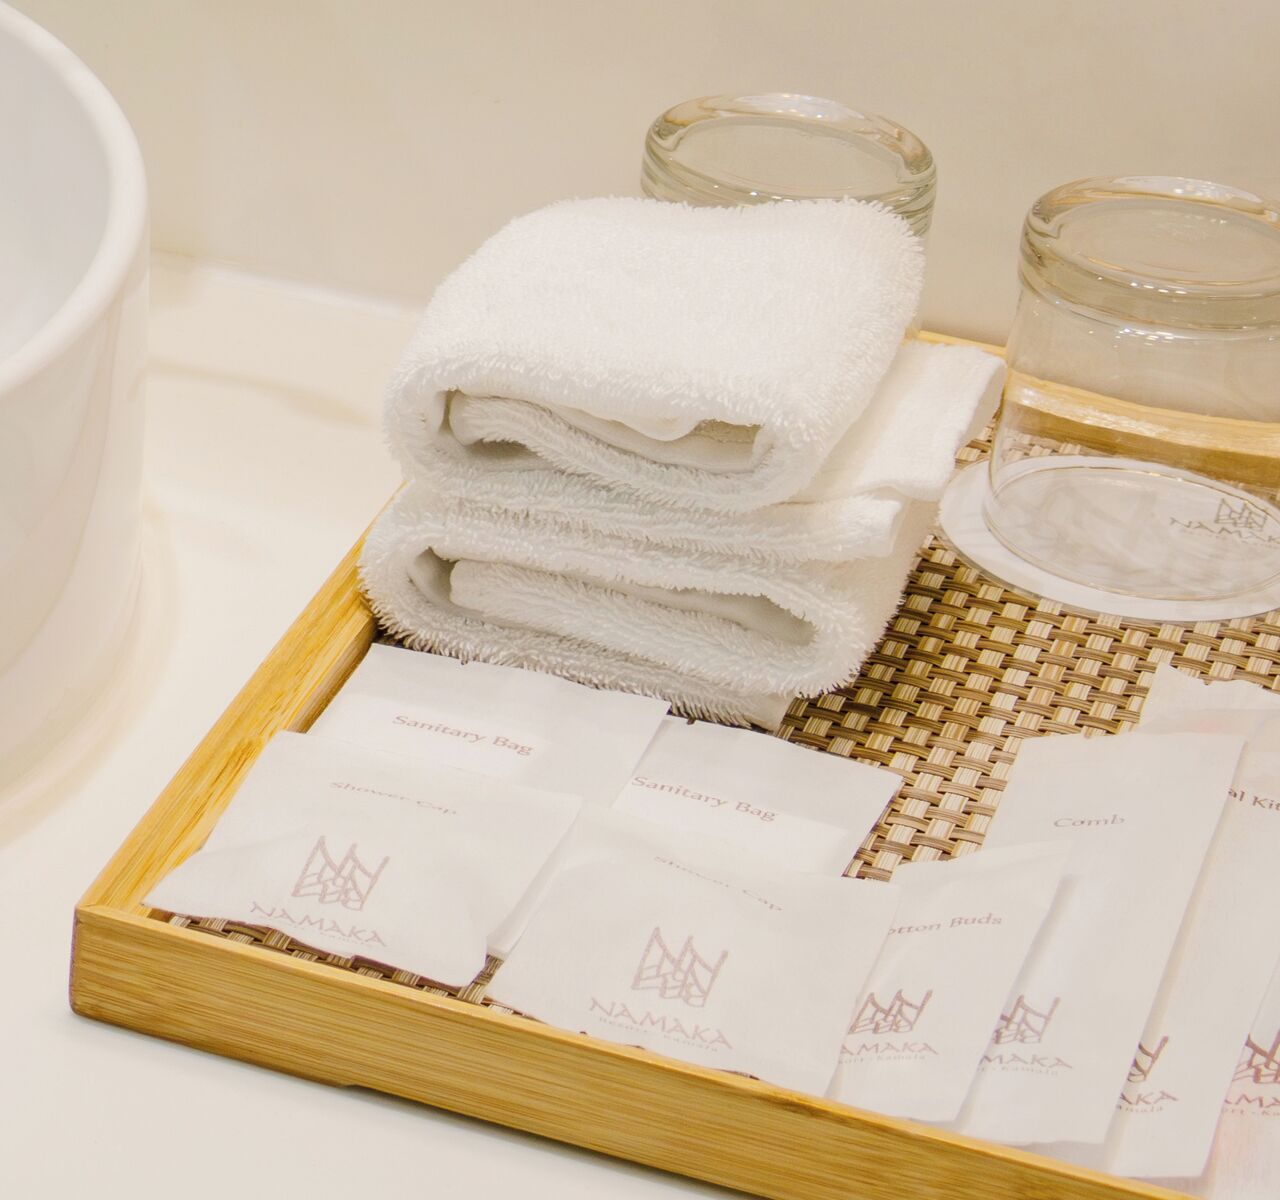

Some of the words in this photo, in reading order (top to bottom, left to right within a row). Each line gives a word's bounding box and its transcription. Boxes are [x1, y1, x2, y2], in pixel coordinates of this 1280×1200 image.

[1169, 516, 1280, 545] NAMAK
[392, 714, 487, 743] Sanitary
[492, 735, 535, 757] Bag
[631, 775, 729, 808] Sanitary
[735, 800, 778, 823] Bag
[1053, 813, 1126, 829] Comb
[250, 900, 388, 949] NAMAKA
[887, 921, 942, 937] otton
[948, 912, 1003, 929] Buds
[589, 996, 734, 1051] NAMAKA
[840, 1041, 940, 1057] AMAKA
[977, 1053, 1074, 1070] MAKA
